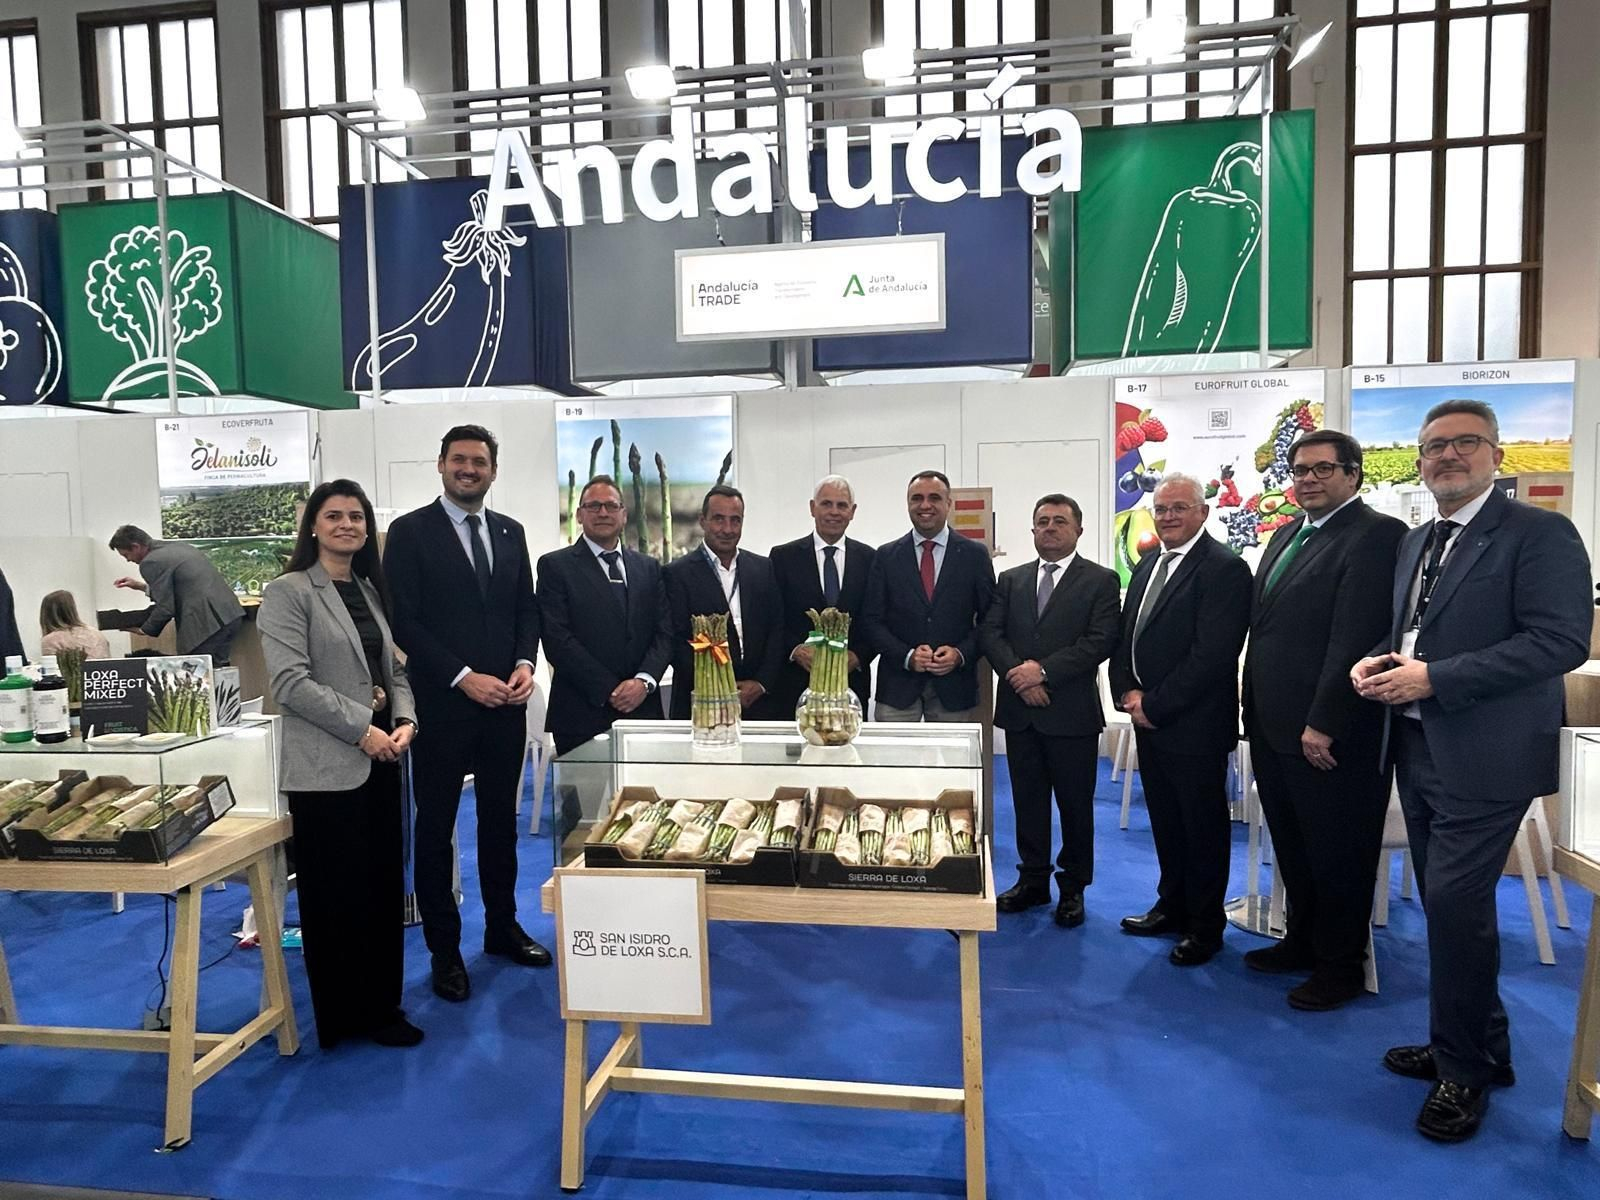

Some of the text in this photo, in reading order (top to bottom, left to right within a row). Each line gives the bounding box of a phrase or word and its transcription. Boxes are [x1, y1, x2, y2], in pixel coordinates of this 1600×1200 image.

[483, 63, 1083, 231] Andalucía
[868, 274, 895, 284] Junta
[698, 280, 758, 294] Andalucía
[868, 281, 928, 294] de Andalucía
[698, 294, 741, 307] TRADE
[1364, 374, 1385, 383] B-15
[1462, 370, 1510, 380] BIORIZON
[1127, 384, 1147, 393] B-17
[1194, 379, 1289, 391] EUROFRUIT GLOBAL
[565, 408, 583, 416] B-19
[164, 423, 179, 431] B-21
[222, 418, 274, 428] ECOVERFRUTA
[84, 669, 118, 681] LOXA
[84, 678, 144, 691] PERFECT
[84, 688, 126, 700] MIXED
[705, 868, 722, 876] OXA
[848, 873, 927, 884] SIERRA DE LOXA
[600, 932, 670, 945] SAN ISIDRO
[601, 945, 692, 958] DE LOXA S.C.A.
